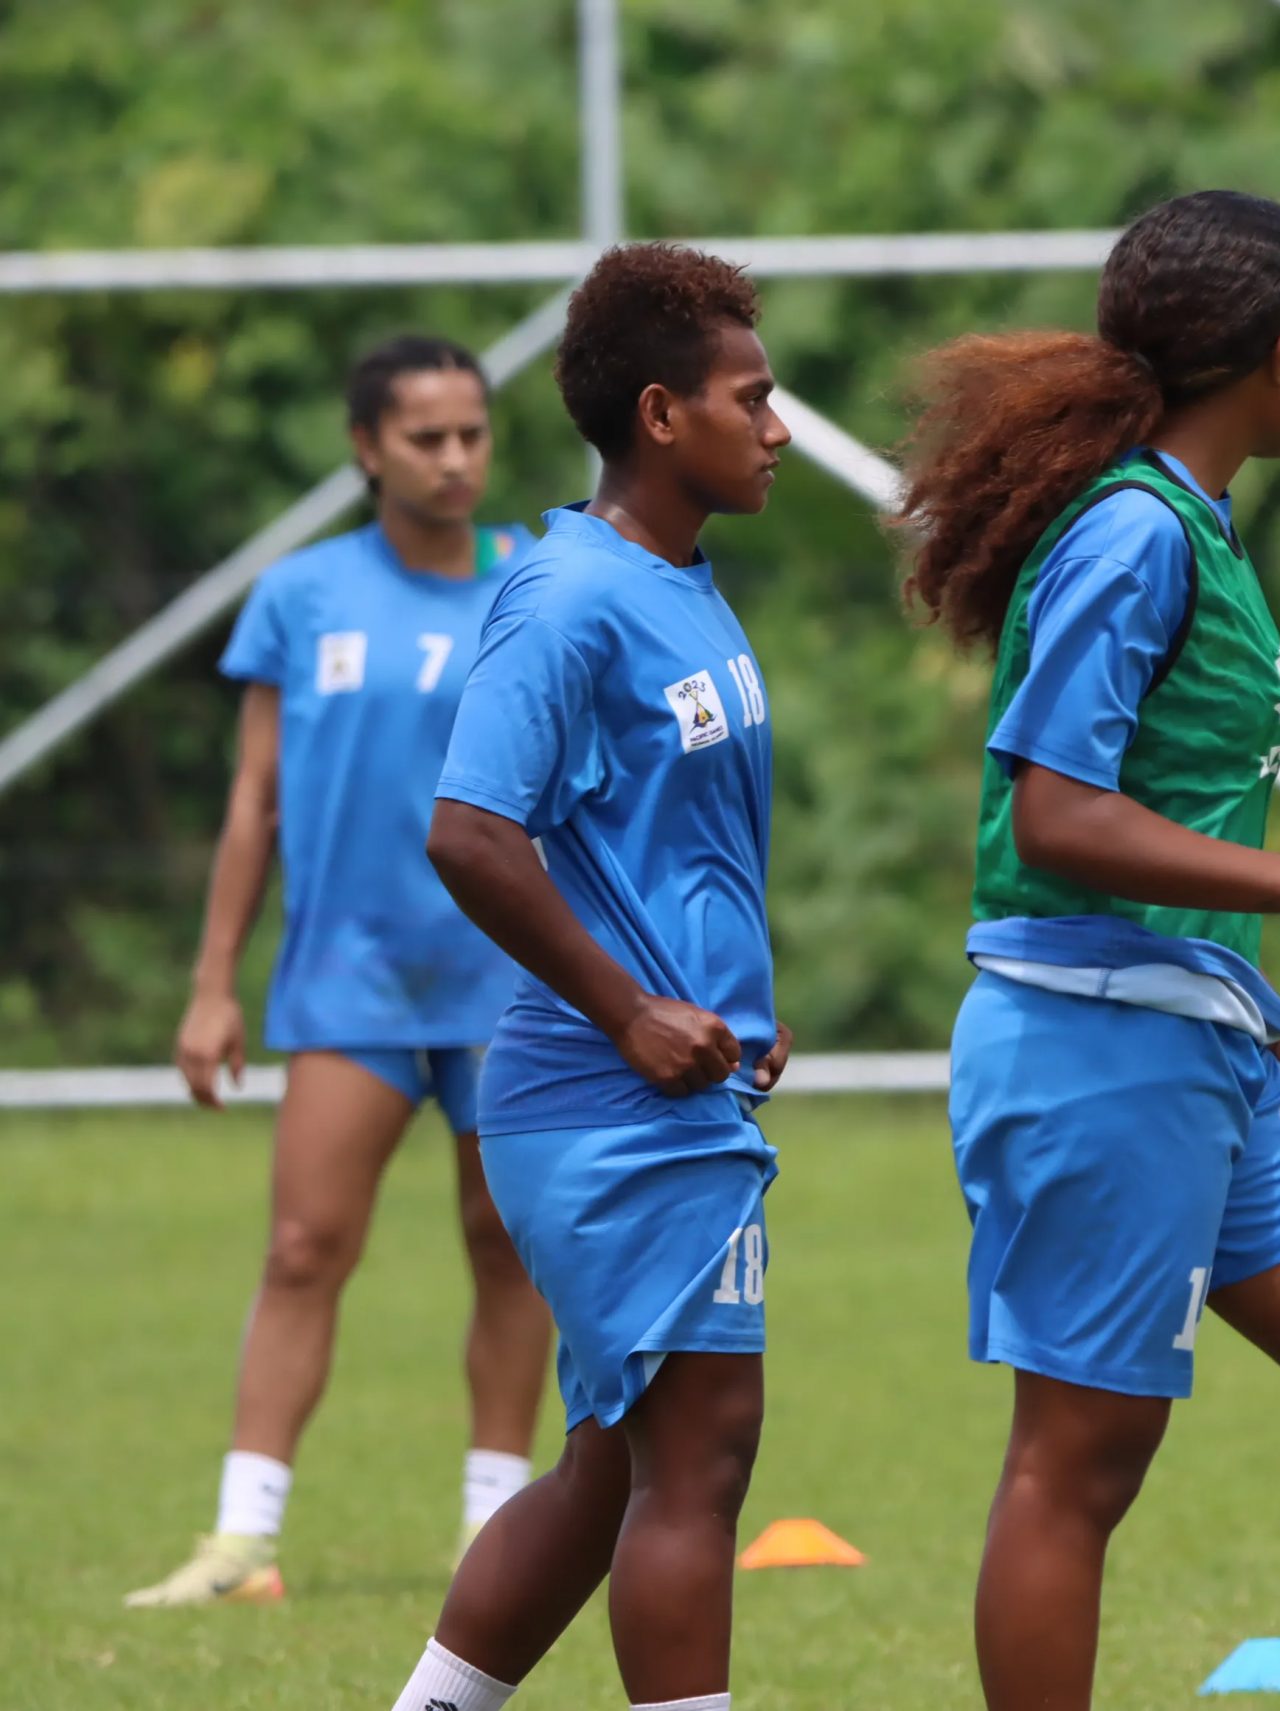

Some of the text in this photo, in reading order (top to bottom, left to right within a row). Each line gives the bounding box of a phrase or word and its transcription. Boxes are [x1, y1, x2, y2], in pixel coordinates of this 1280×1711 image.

[416, 632, 454, 693] 7
[678, 680, 706, 699] 2023
[727, 653, 765, 728] 18
[713, 1224, 764, 1305] 18
